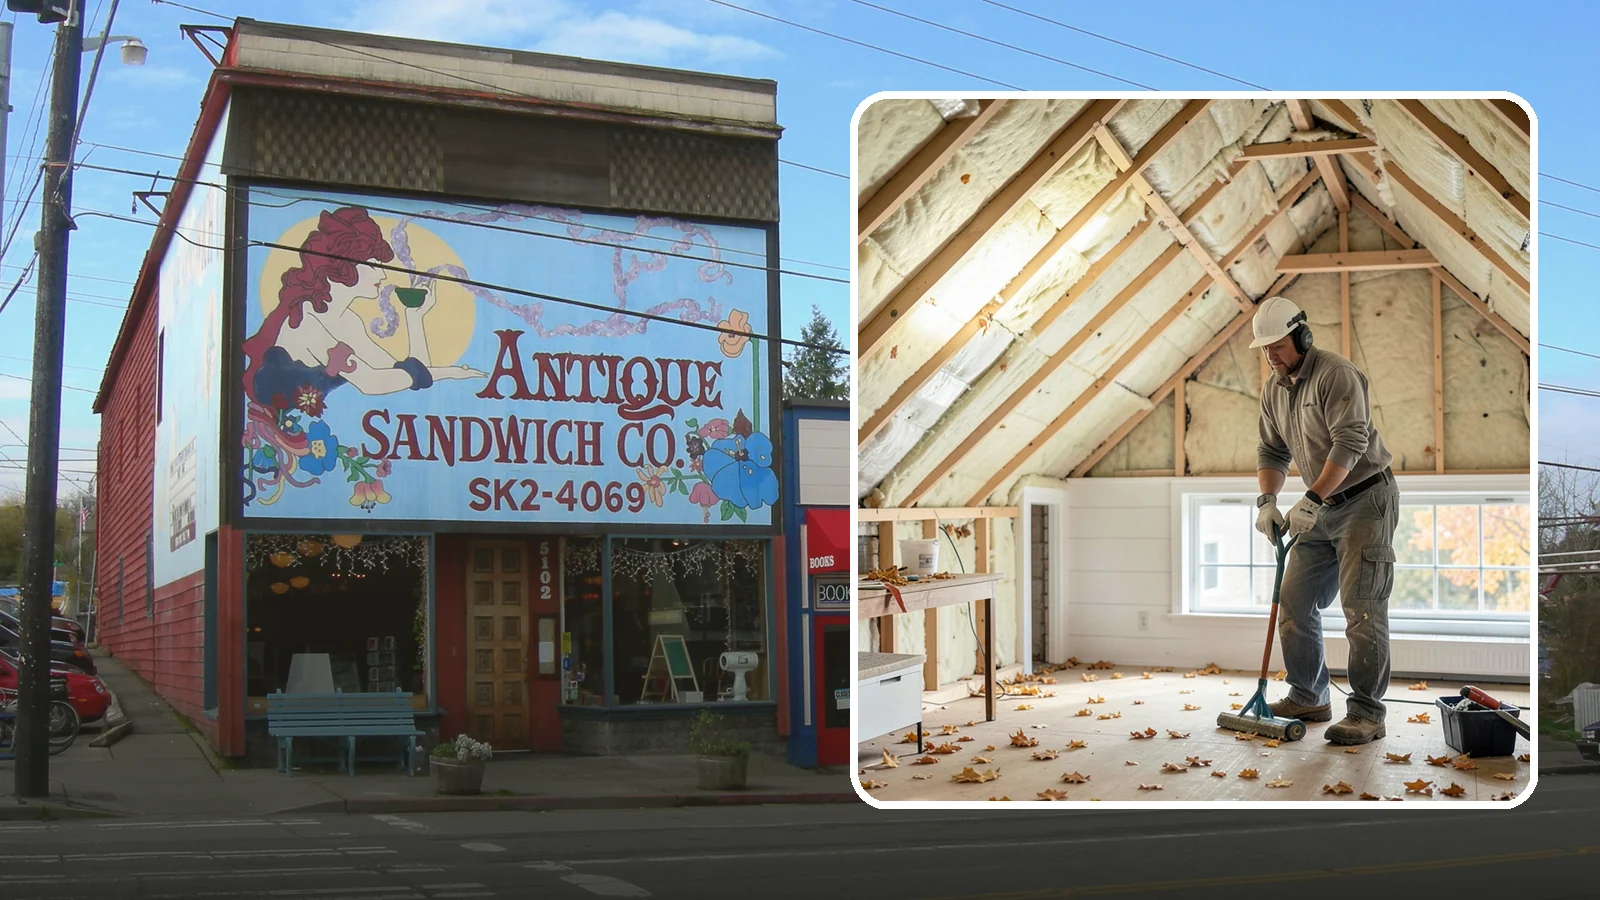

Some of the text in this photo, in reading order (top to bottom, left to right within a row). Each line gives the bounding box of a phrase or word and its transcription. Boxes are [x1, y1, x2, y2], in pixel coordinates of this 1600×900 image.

[477, 330, 723, 420] ANTIQUE
[361, 408, 685, 468] SANDWICH CO.
[468, 477, 646, 512] SK2-4069
[540, 541, 551, 600] 5102
[809, 554, 835, 569] BOOKS
